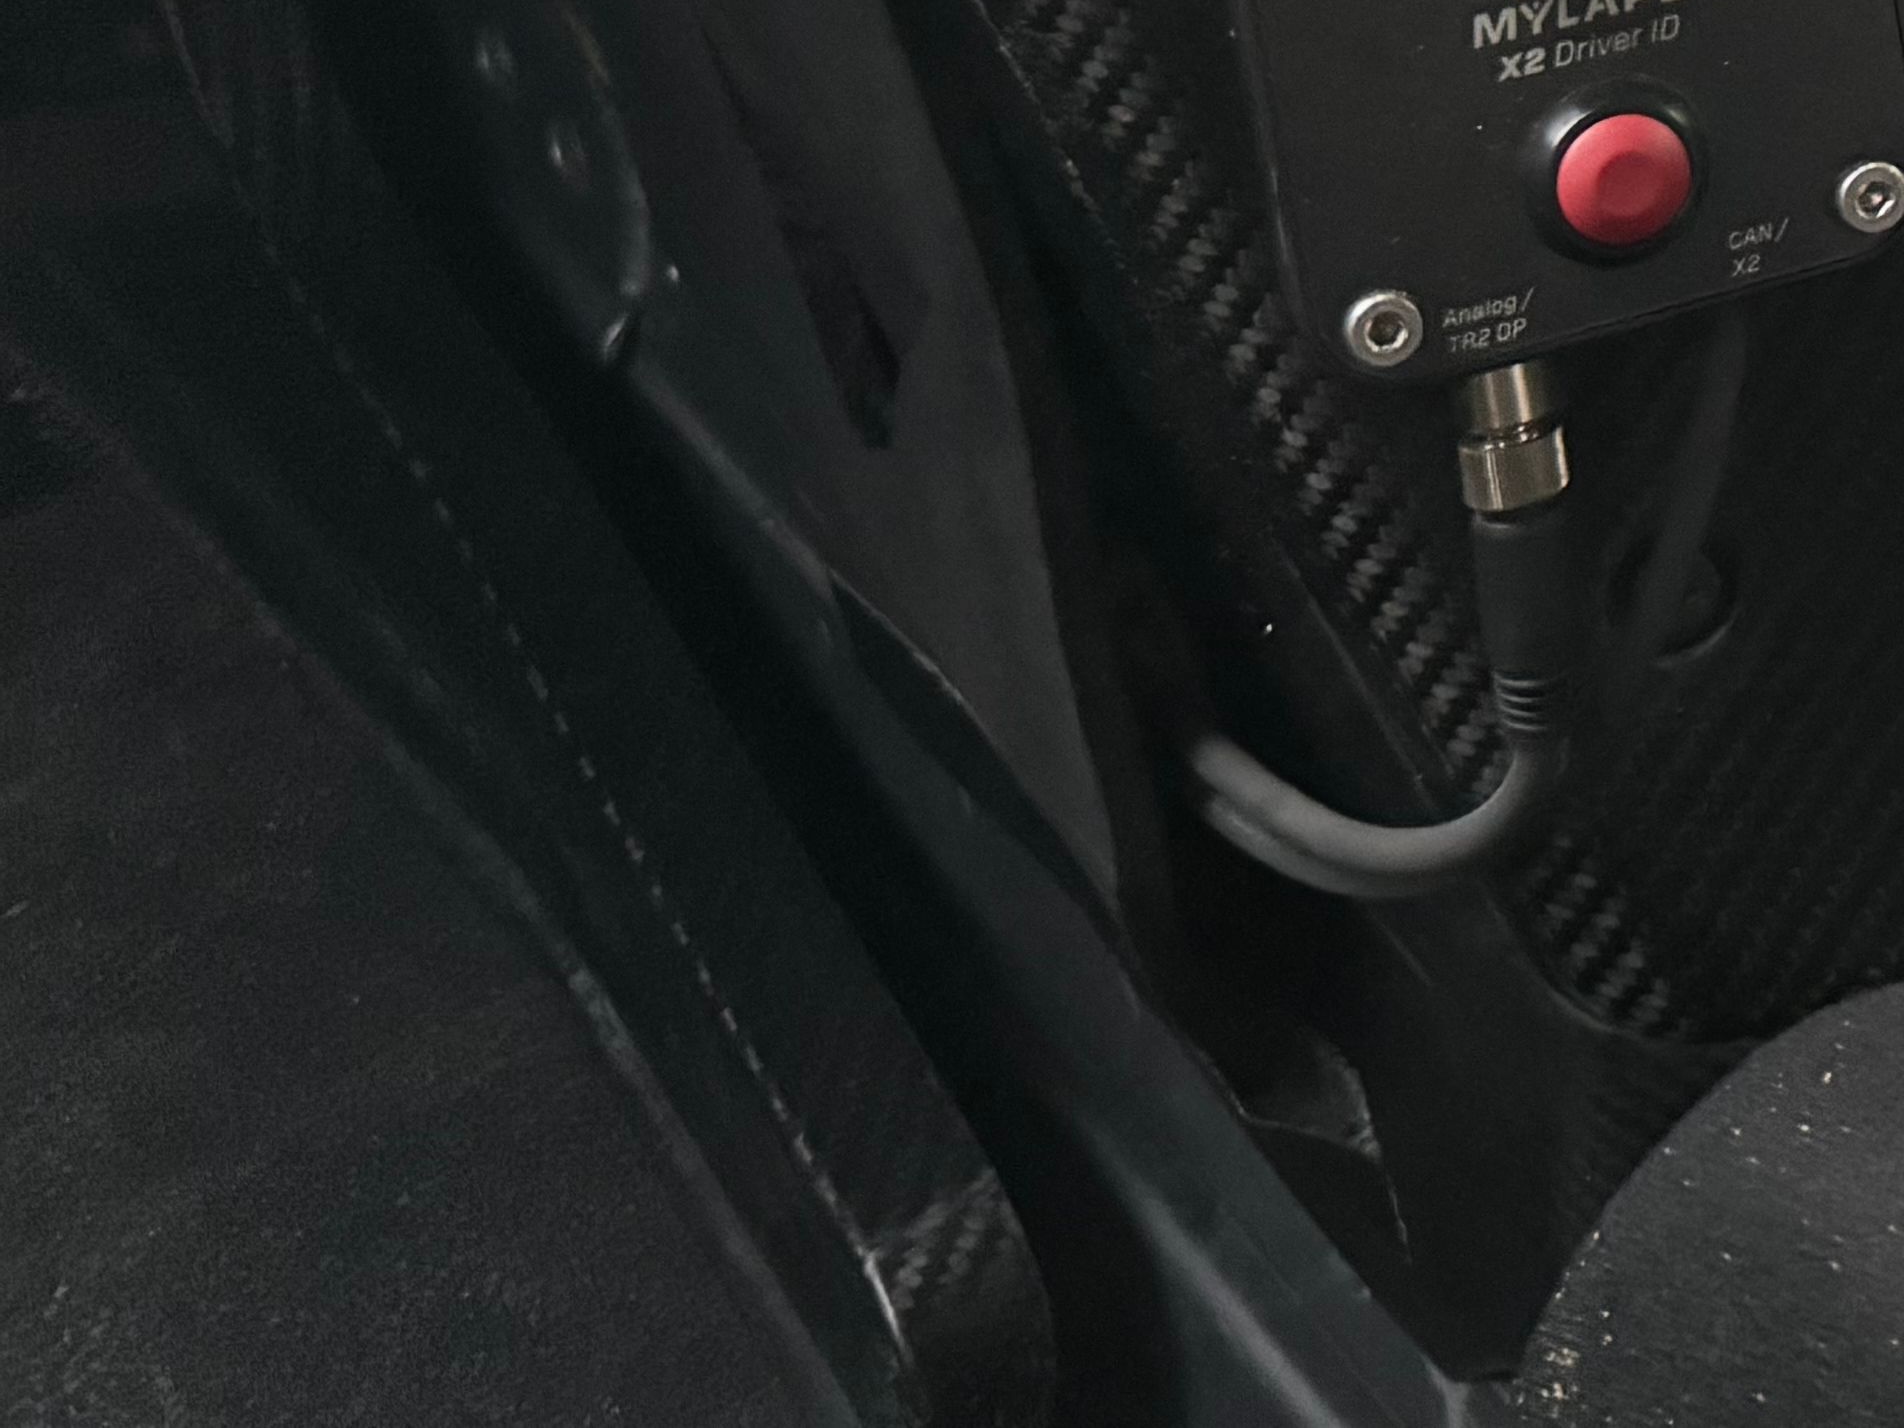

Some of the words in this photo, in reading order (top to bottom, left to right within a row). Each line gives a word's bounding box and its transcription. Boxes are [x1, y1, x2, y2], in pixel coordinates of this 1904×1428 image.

[1498, 47, 1546, 82] X2
[1555, 27, 1643, 68] Driver
[1652, 14, 1681, 43] ID
[1732, 254, 1760, 278] X2
